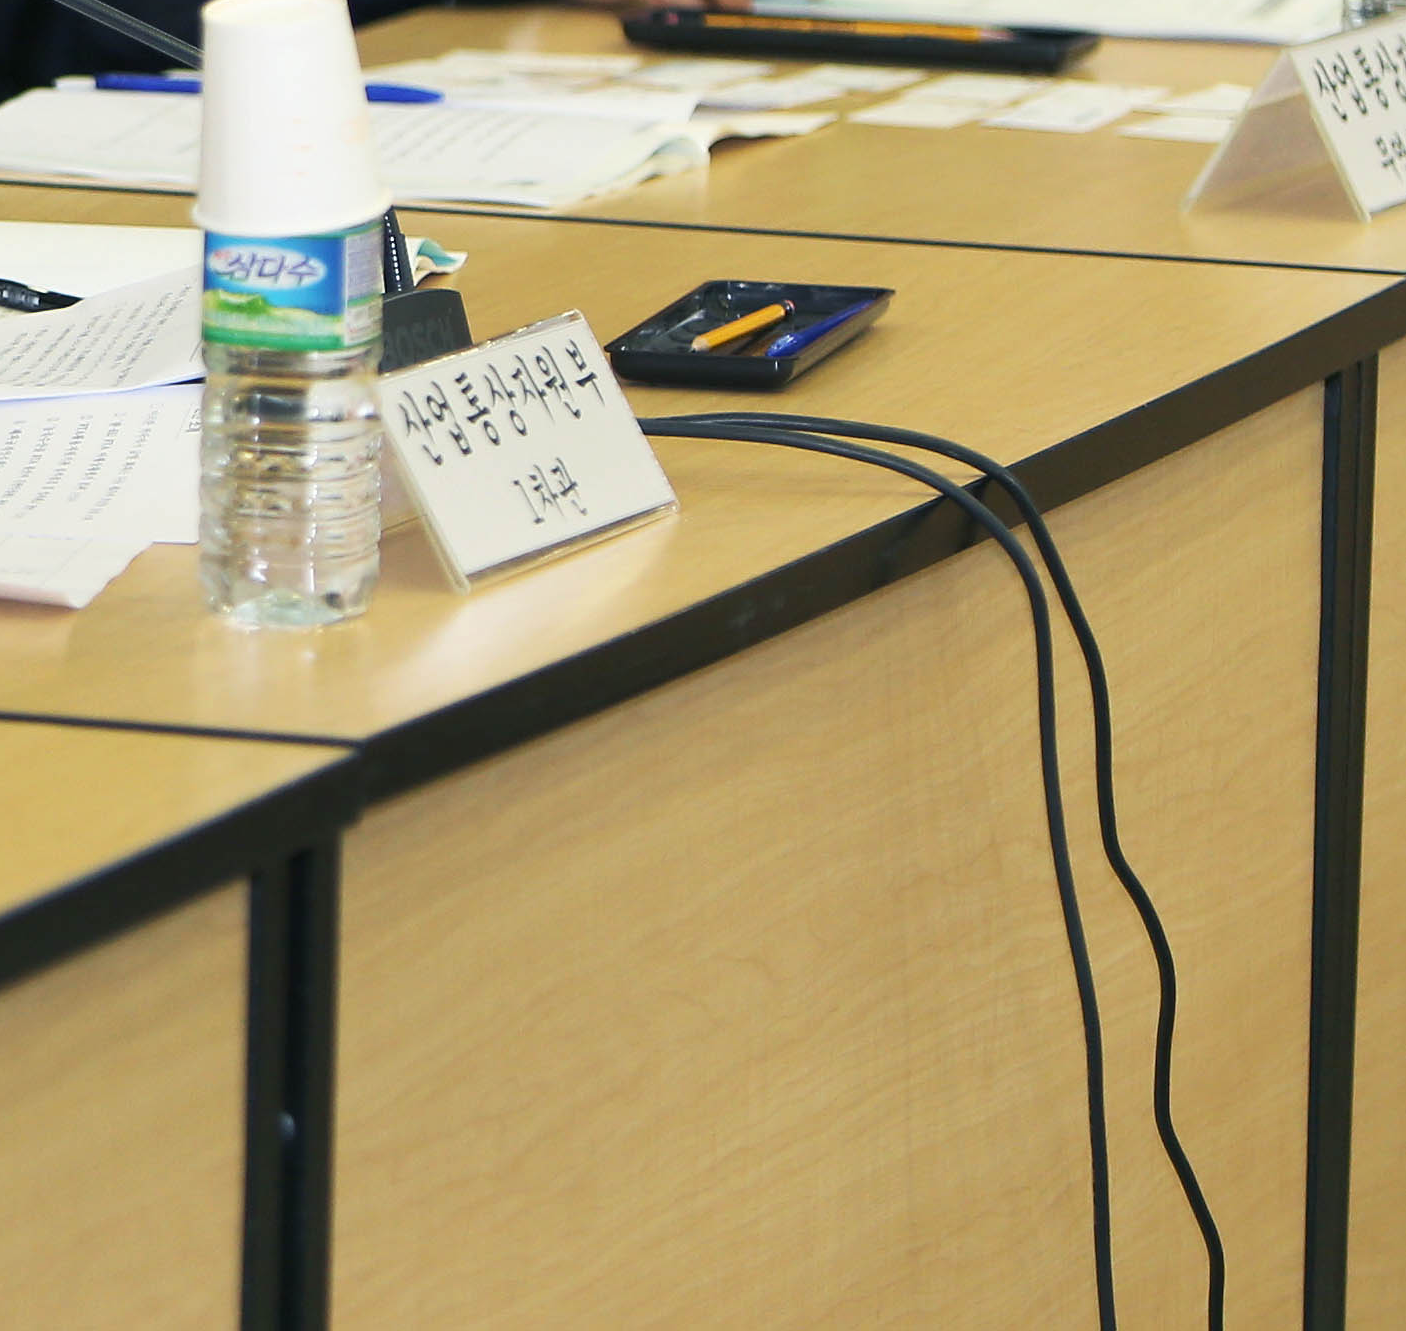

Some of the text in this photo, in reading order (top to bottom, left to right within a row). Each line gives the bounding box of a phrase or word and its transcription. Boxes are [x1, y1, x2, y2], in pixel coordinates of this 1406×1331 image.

[1312, 34, 1406, 121] 산업통상
[227, 252, 320, 286] 삼다수
[398, 339, 605, 466] 산업통상자원부
[512, 457, 588, 524] 1차관
